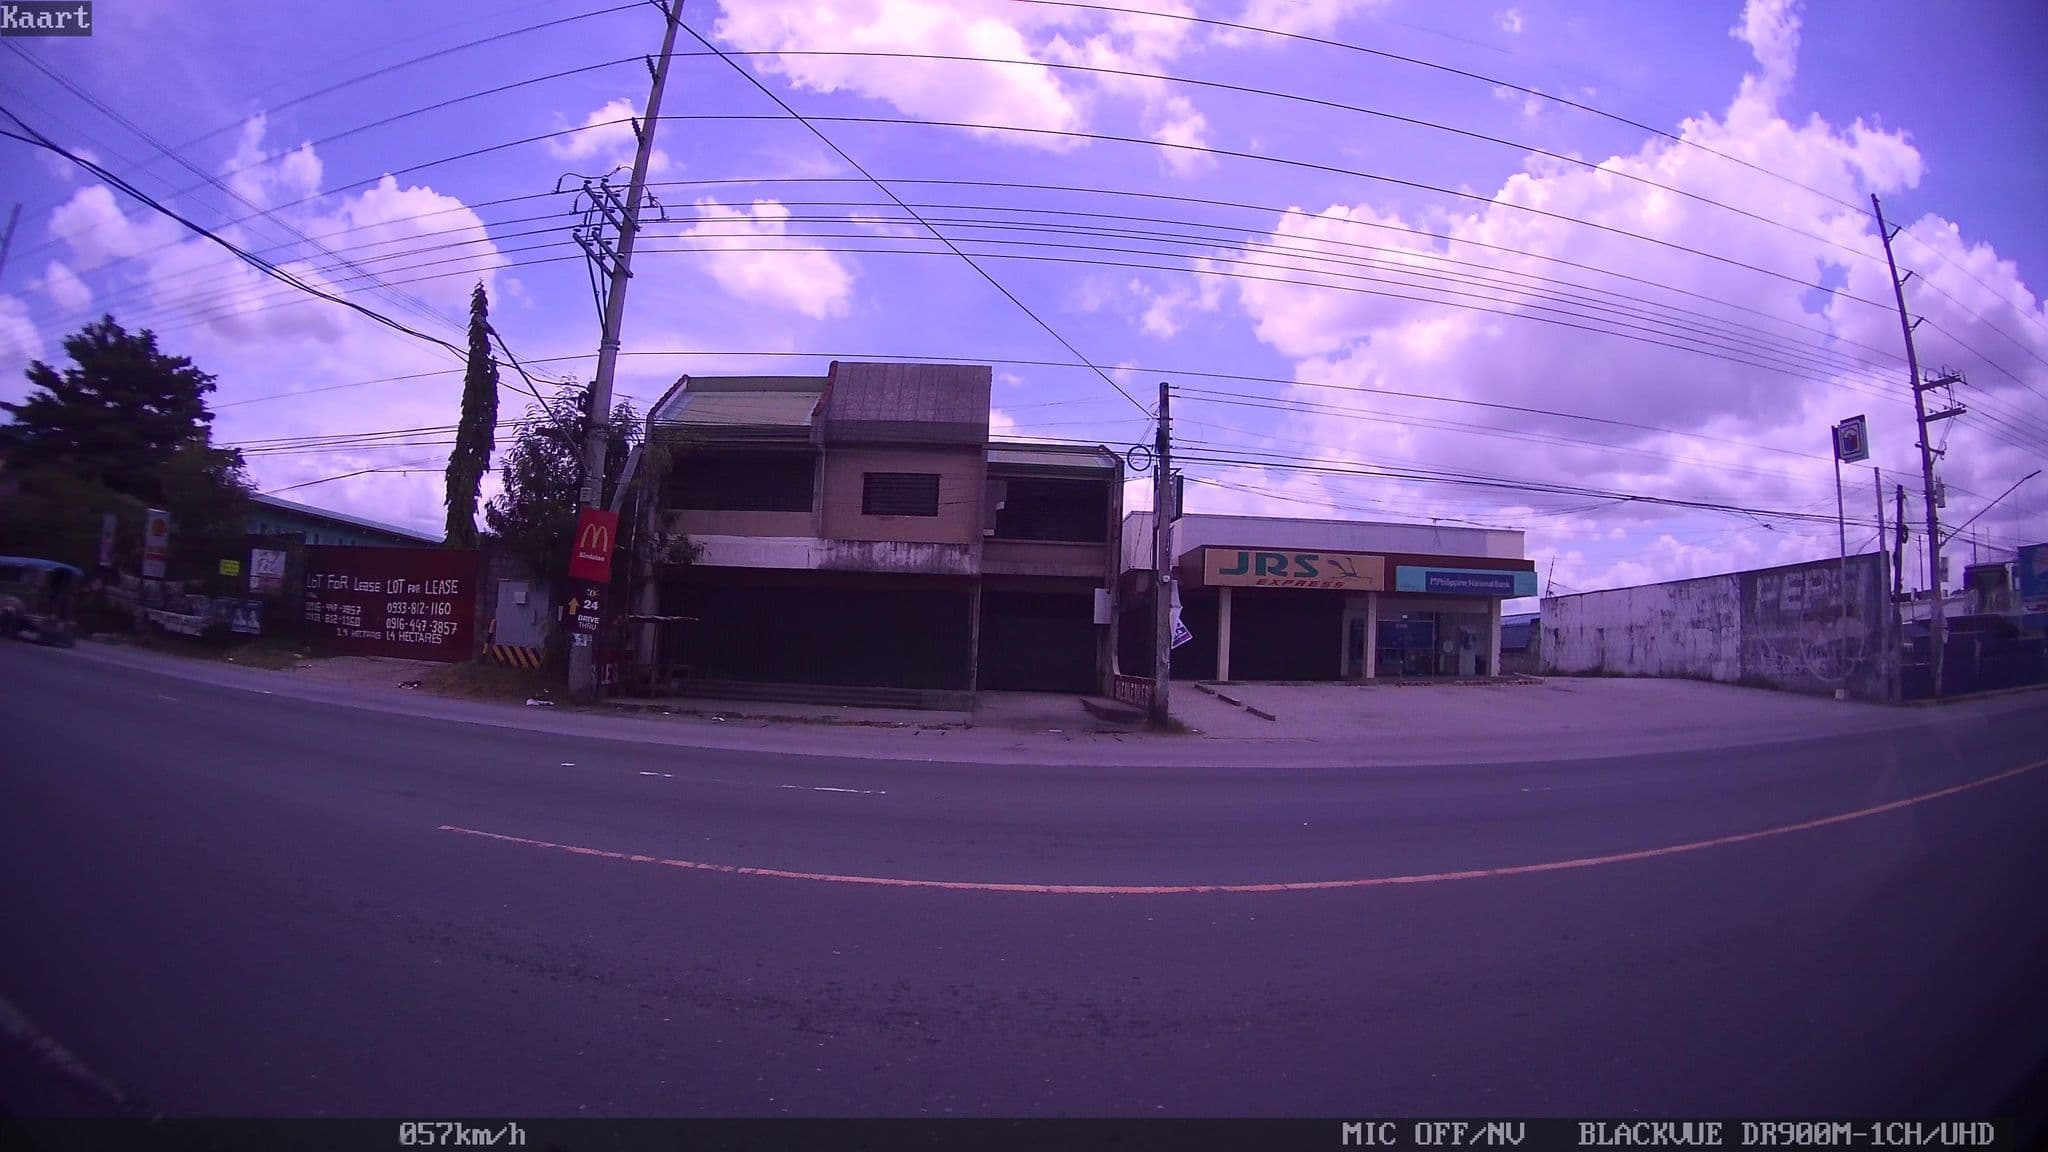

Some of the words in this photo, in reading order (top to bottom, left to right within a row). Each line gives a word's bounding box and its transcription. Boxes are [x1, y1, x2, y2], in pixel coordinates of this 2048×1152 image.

[1218, 552, 1320, 578] JRS
[387, 579, 406, 594] LOT
[425, 580, 459, 595] LEASE
[1256, 578, 1345, 588] EXPRESS
[1439, 577, 1468, 588] Philippine
[1468, 578, 1494, 588] National
[1494, 579, 1511, 588] Bank
[583, 599, 599, 610] 24
[577, 614, 600, 624] DRIVE
[578, 621, 597, 631] THRU
[398, 631, 442, 644] HECTARES
